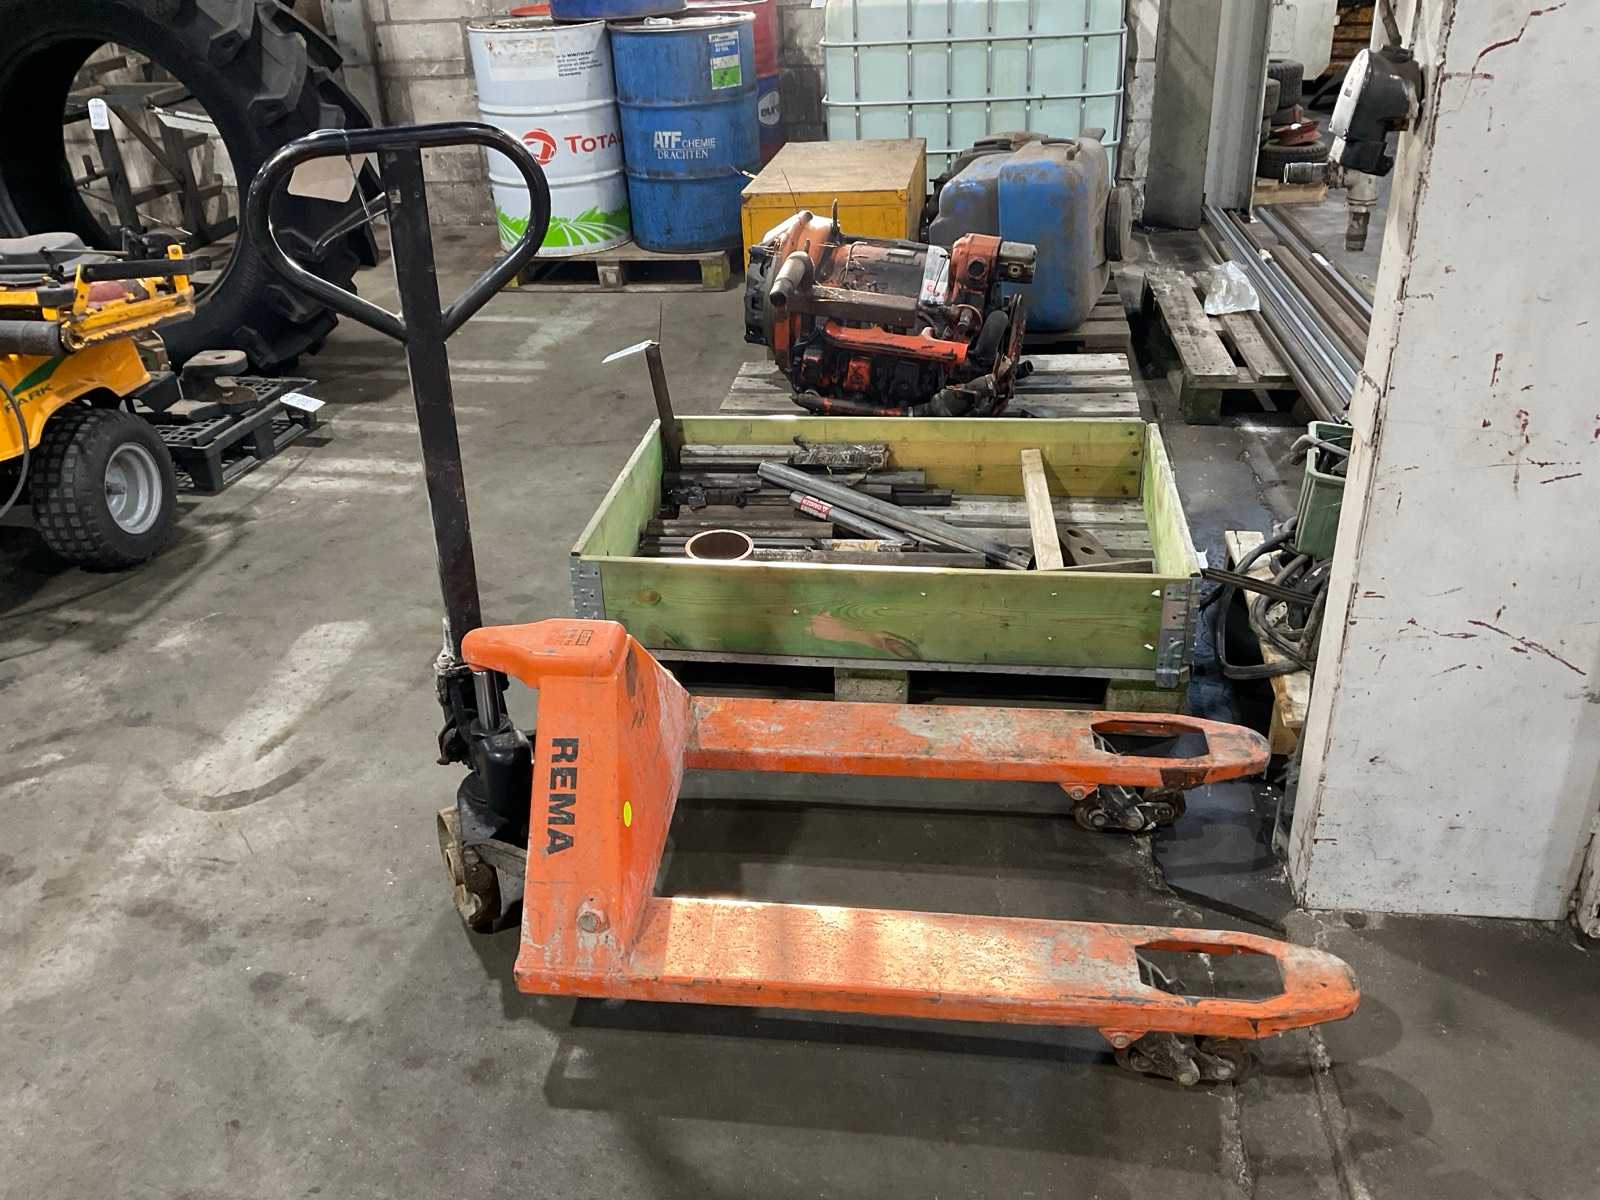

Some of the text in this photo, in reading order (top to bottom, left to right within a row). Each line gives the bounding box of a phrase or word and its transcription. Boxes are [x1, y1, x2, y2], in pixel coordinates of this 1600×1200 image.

[653, 131, 716, 149] ATF CHEMIE
[657, 149, 709, 160] DRACHTEN
[547, 737, 579, 854] REMA
